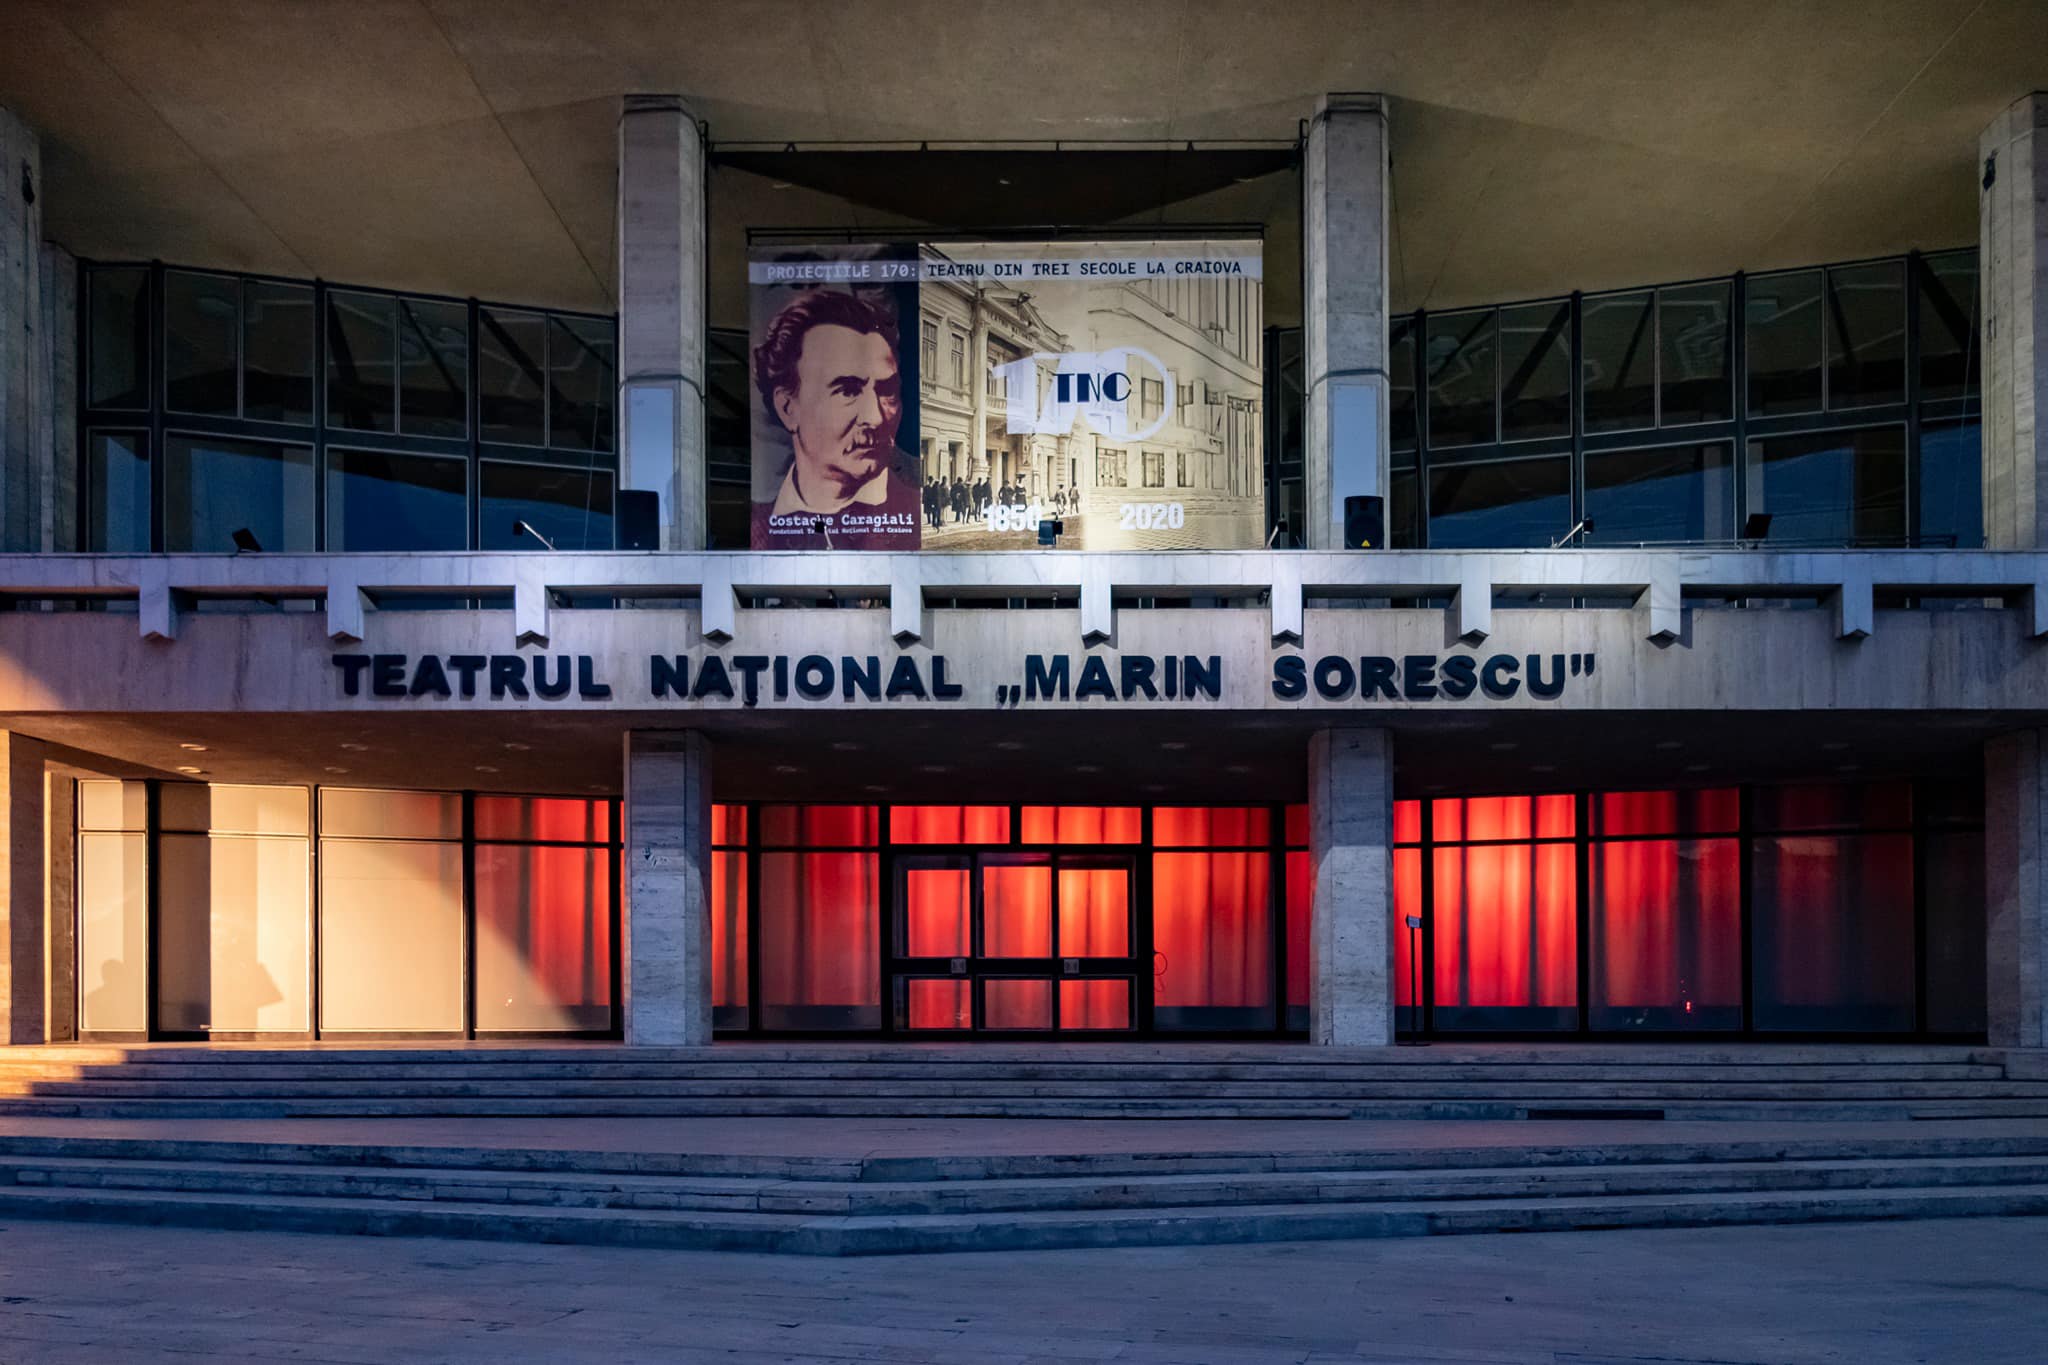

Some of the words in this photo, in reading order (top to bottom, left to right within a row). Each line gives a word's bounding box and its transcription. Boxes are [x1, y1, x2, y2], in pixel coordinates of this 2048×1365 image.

[880, 263, 918, 279] 170:
[928, 263, 985, 277] TEATRU
[994, 263, 1023, 276] DIN
[1032, 263, 1070, 276] TREI
[1080, 262, 1137, 275] SECOLE
[1147, 262, 1165, 274] LA
[1176, 260, 1242, 274] CRAIOVA
[1053, 371, 1132, 404] TNC
[841, 513, 914, 527] Caragiali
[1119, 502, 1185, 530] 2020
[332, 654, 613, 698] TEATRUL
